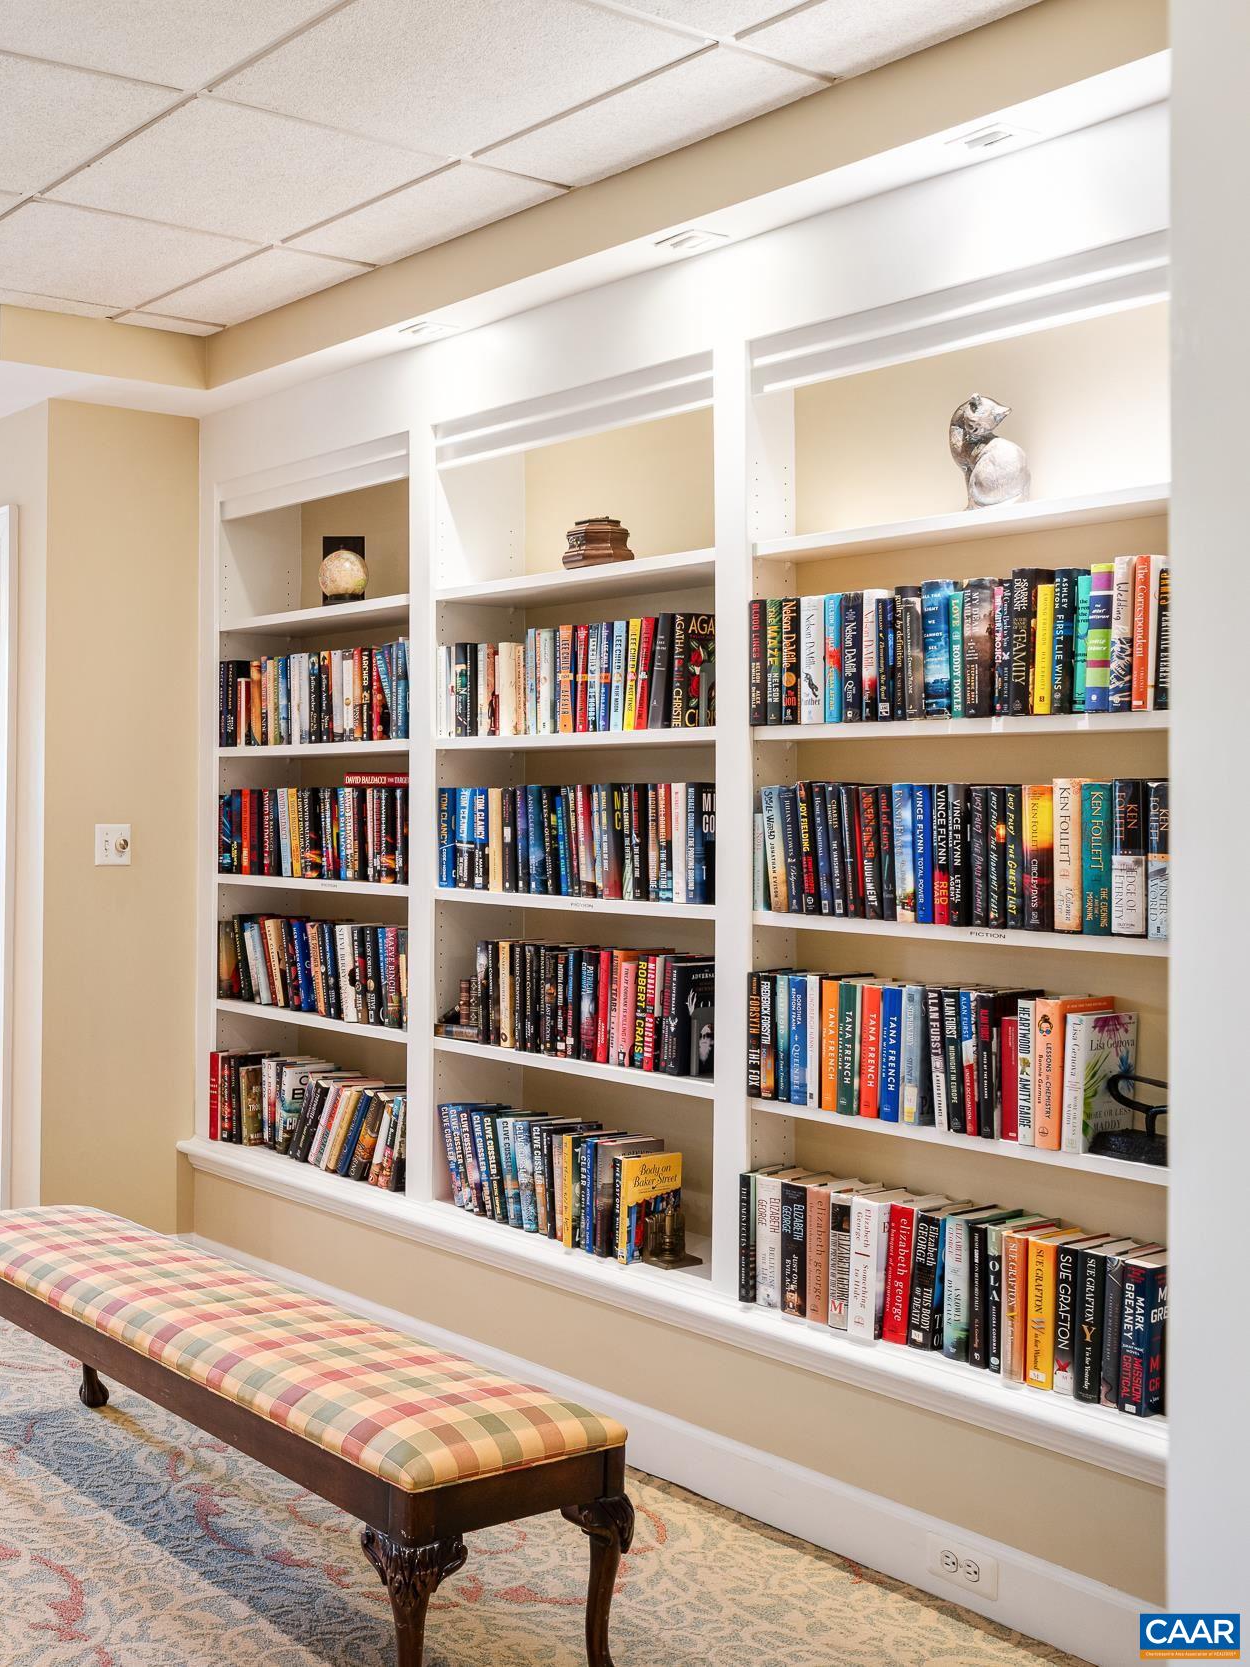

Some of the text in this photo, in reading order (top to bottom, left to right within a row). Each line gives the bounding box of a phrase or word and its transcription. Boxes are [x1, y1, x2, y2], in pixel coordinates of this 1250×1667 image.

[782, 601, 796, 668] Nelson DeMille
[1135, 563, 1148, 657] The Correspondent
[672, 615, 685, 727] AGATHA CHRISTIE
[767, 626, 779, 666] MAZE
[952, 600, 962, 711] LOVE RODDY DOYLE
[1054, 614, 1064, 690] FIRST LIE WINS
[440, 793, 448, 845] TOM CLANCY
[477, 812, 485, 839] CLANCY
[915, 791, 924, 821] VINCE
[936, 790, 947, 865] VINCE FLYNN
[1059, 787, 1071, 865] KEN FOLLETT
[1090, 791, 1104, 872] KEN FOLLETT
[1127, 804, 1138, 829] KEN
[801, 817, 810, 852] FIELDING
[916, 823, 924, 853] FLYNN
[952, 800, 962, 866] VINCE FLYNN
[940, 881, 948, 905] RED
[388, 933, 397, 997] MAEVE BINCHY
[635, 961, 647, 1053] ROBERT CRAIS
[845, 1011, 853, 1039] TANA
[928, 992, 941, 1057] ALAN FURST
[644, 1016, 653, 1058] CRICHTON
[749, 996, 760, 1086] FORSYTH THE FOX
[867, 1013, 877, 1087] TANA FRENCH
[887, 1017, 897, 1091] TANA FRENCH
[1018, 1007, 1031, 1129] HEARTWOOD AMITY GAIGE
[444, 1129, 454, 1161] CUSSLER
[453, 1132, 463, 1164] CUSSLER
[460, 1113, 472, 1163] CLIVE CUSSLER
[484, 1117, 497, 1174] CLIVE CUSSLER
[504, 1142, 512, 1173] CUSSLER
[532, 1126, 544, 1185] CLIVE CUSSLER
[476, 1138, 486, 1172] CUSSLER
[482, 1181, 491, 1210] PIRATE
[633, 1173, 678, 1188] Baker Street
[640, 1164, 671, 1176] Body on
[758, 1199, 767, 1227] GEORGE
[769, 1197, 780, 1233] ELIZABETH
[793, 1203, 804, 1241] ELIZABETH
[813, 1200, 826, 1301] elizabeth george
[915, 1222, 928, 1263] GEORGE
[926, 1225, 939, 1267] Elizabeth
[894, 1218, 910, 1322] elizabeth george
[1084, 1258, 1096, 1324] SUE GRAFTON
[921, 1308, 931, 1331] BODY
[1057, 1254, 1072, 1351] SUE GRAFTON
[1123, 1283, 1135, 1340] GREANEY
[1135, 1296, 1145, 1332] MARK
[1120, 1354, 1131, 1399] CRITICAL
[1133, 1357, 1142, 1403] MISSION
